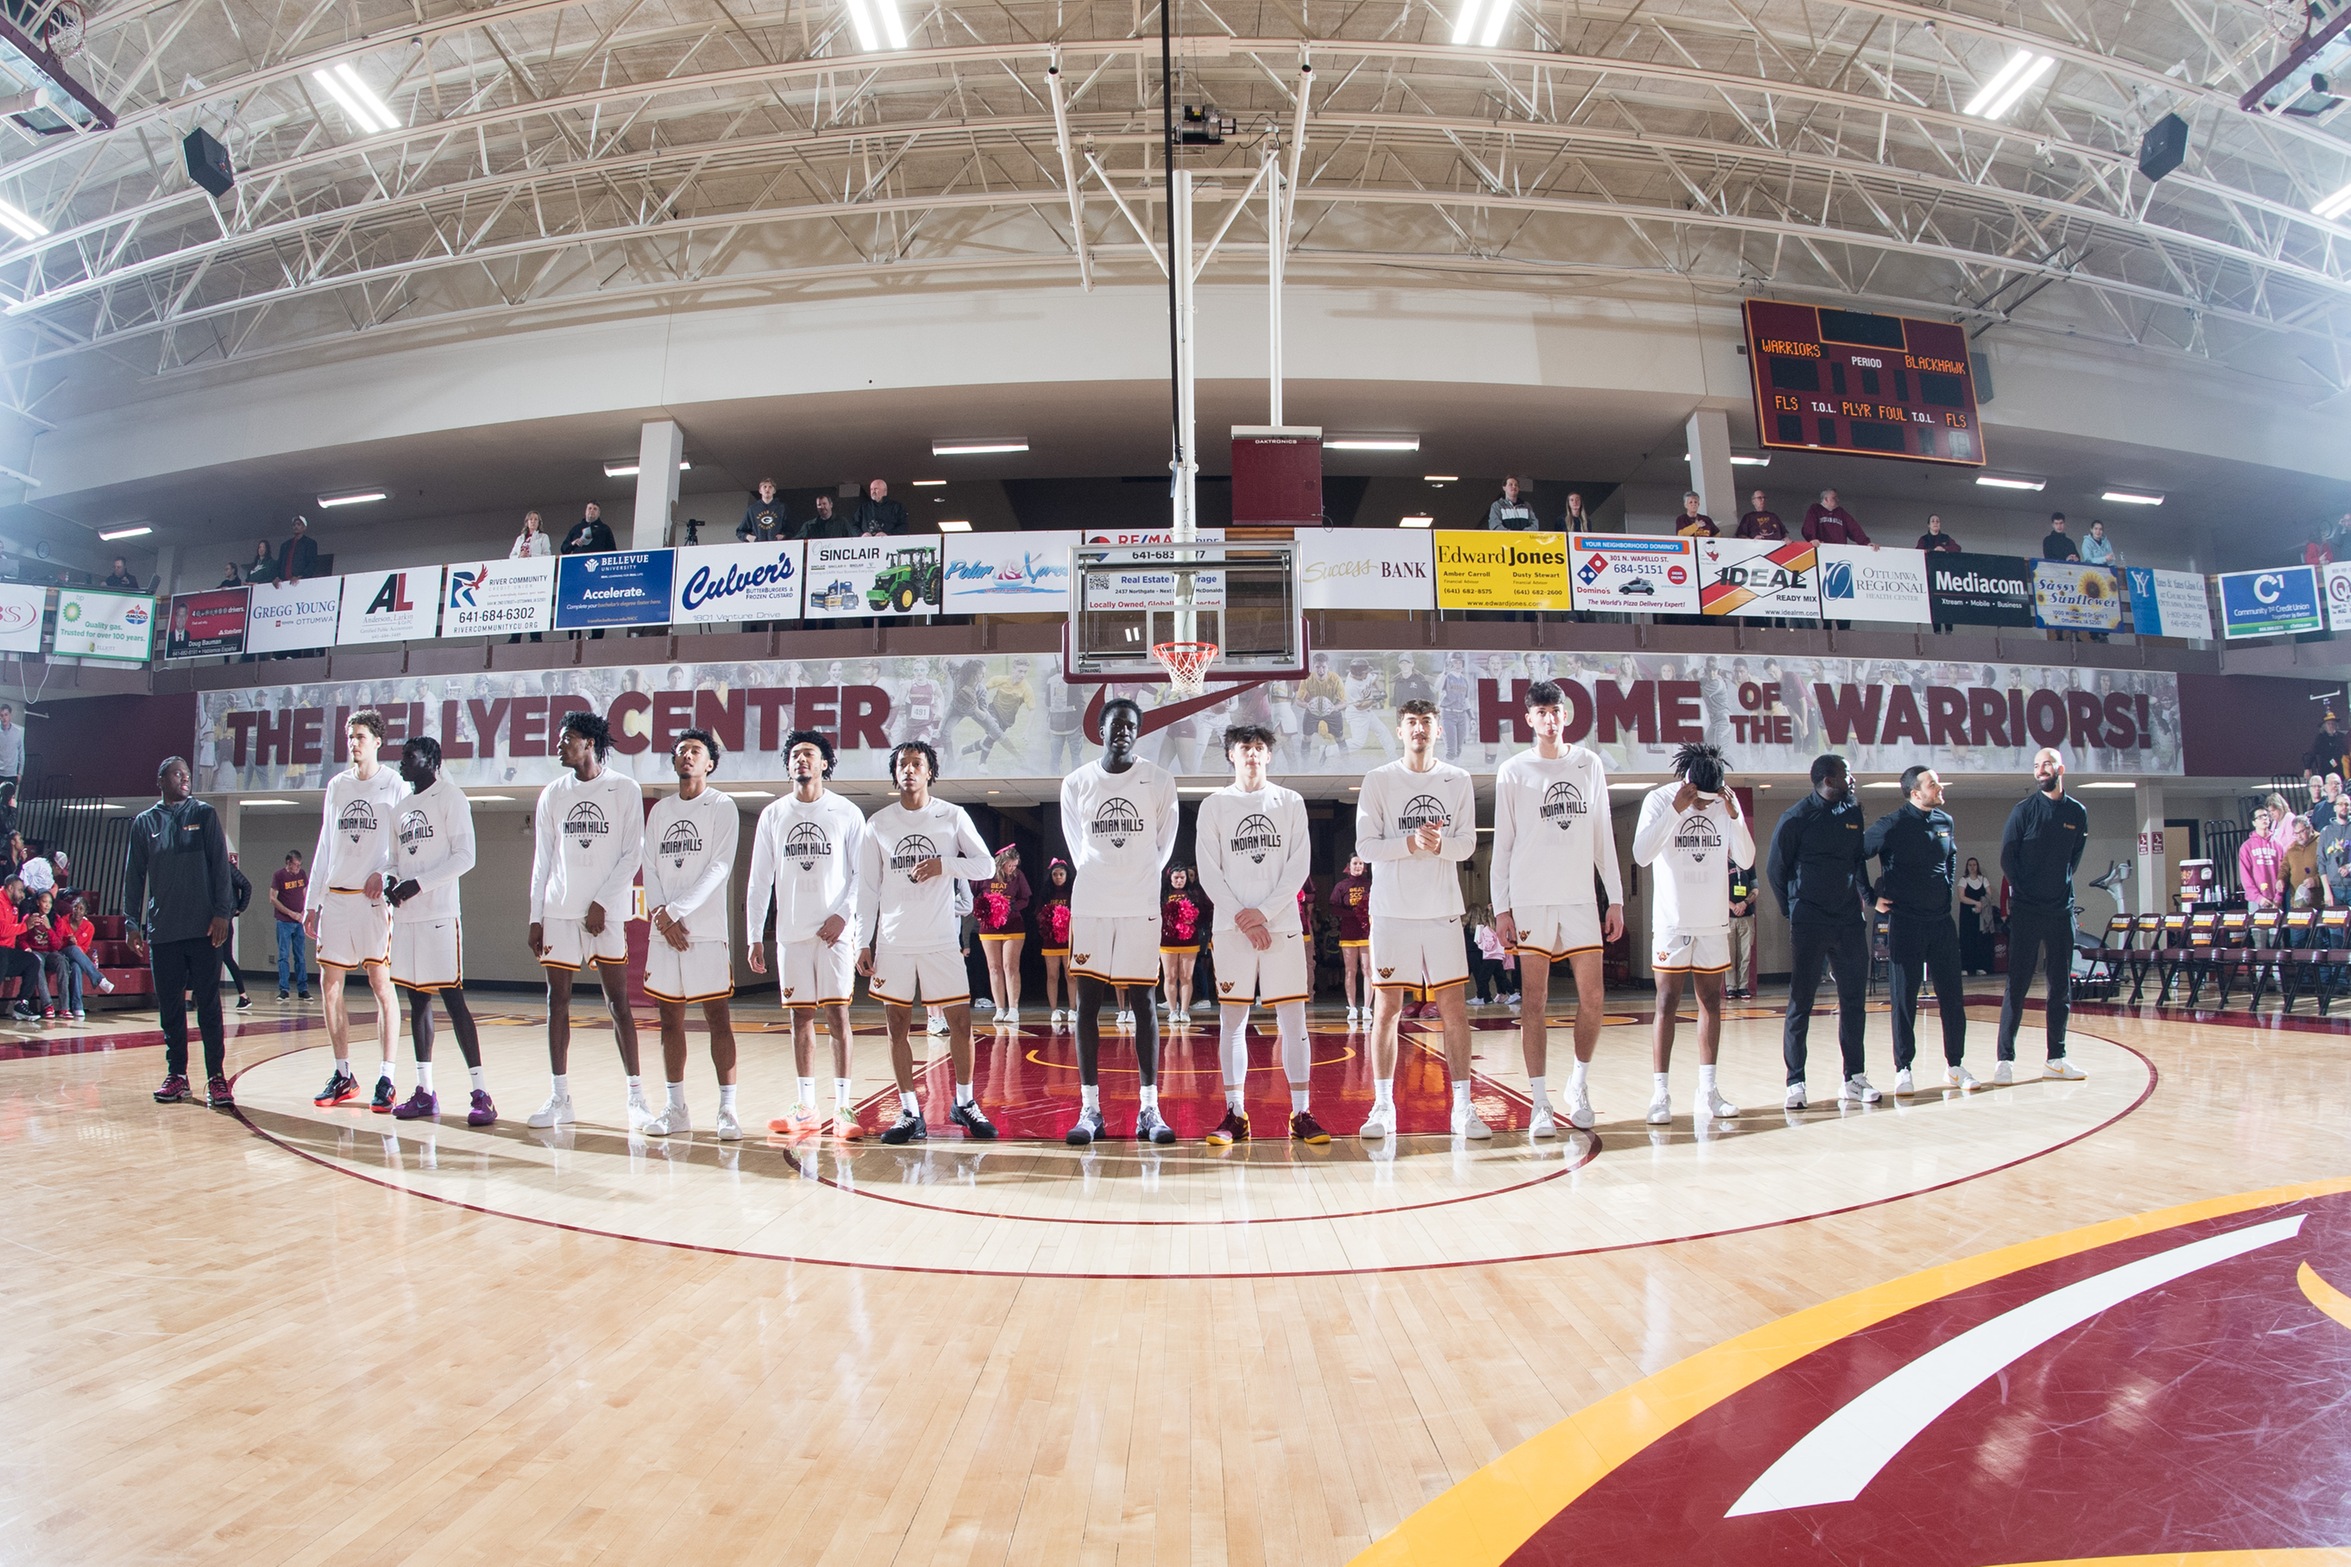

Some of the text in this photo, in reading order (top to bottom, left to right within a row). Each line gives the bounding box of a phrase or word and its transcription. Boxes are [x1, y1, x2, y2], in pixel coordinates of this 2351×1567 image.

[1761, 338, 1821, 358] WARRIORS
[1851, 356, 1882, 369] PERIOD
[1905, 354, 1966, 375] BLACKHAWK
[1775, 395, 1798, 411] FLS
[1811, 402, 1837, 413] T.O.L.
[1842, 401, 1907, 422] PLYR FOUL
[1911, 412, 1935, 424] T.O.L.
[1945, 413, 1967, 428] FLS
[601, 554, 649, 566] BELLEVUE
[820, 548, 880, 561] SINCLAIR
[1438, 545, 1565, 567] Edward Jones
[944, 560, 994, 580] Polar
[1302, 559, 1427, 583] Success BANK
[1613, 563, 1663, 574] 684-5151
[1862, 567, 1918, 581] OTTUMWA
[489, 575, 548, 586] RIVER COMMUNITY
[681, 552, 795, 610] Culver's
[1142, 575, 1170, 583] Estate
[1720, 567, 1807, 589] IDEAL
[1935, 571, 2025, 594] Mediacom
[583, 586, 646, 600] Accelerate.
[1577, 586, 1611, 595] Domino's
[1856, 580, 1926, 594] REGIONAL
[2039, 579, 2077, 593] Sassy
[365, 572, 414, 615] AL
[2050, 592, 2117, 607] Sunflower
[253, 600, 336, 619] GREGG YOUNG
[566, 603, 587, 611] Complete
[1089, 600, 1147, 609] Locally Owned,
[1970, 599, 1990, 607] Mobile
[2233, 607, 2268, 616] Community
[2275, 604, 2292, 613] Credit
[2293, 603, 2310, 611] Union
[296, 616, 334, 625] OTTUMWA
[459, 607, 535, 623] 641-684-6302
[716, 613, 753, 621] Venture
[85, 621, 108, 630] Quality
[454, 621, 538, 633] RIVERCOMMUNITYCU.ORG
[61, 628, 84, 637] Trusted
[86, 630, 96, 638] for
[188, 640, 201, 648] Doug
[1737, 682, 1781, 711] OF
[1477, 678, 1704, 743] HOME
[1813, 683, 2151, 750] WARRIORS!
[226, 706, 324, 767] THE
[606, 685, 891, 755] CENTER
[1729, 715, 1793, 744] THE
[1566, 801, 1587, 814] HILLS
[338, 818, 378, 831] INDIAN HILLS
[563, 821, 609, 834] INDIAN HILLS
[1091, 818, 1144, 834] INDIAN HILLS
[1398, 815, 1426, 830] INDIAN
[414, 825, 434, 839] HILLS
[659, 838, 702, 854] INDIAN HILLS
[1230, 834, 1281, 852] INDIAN HILLS
[1674, 835, 1721, 848] INDIAN HILLS
[784, 842, 831, 857] INDIAN HILLS
[890, 855, 916, 870] INDIAN
